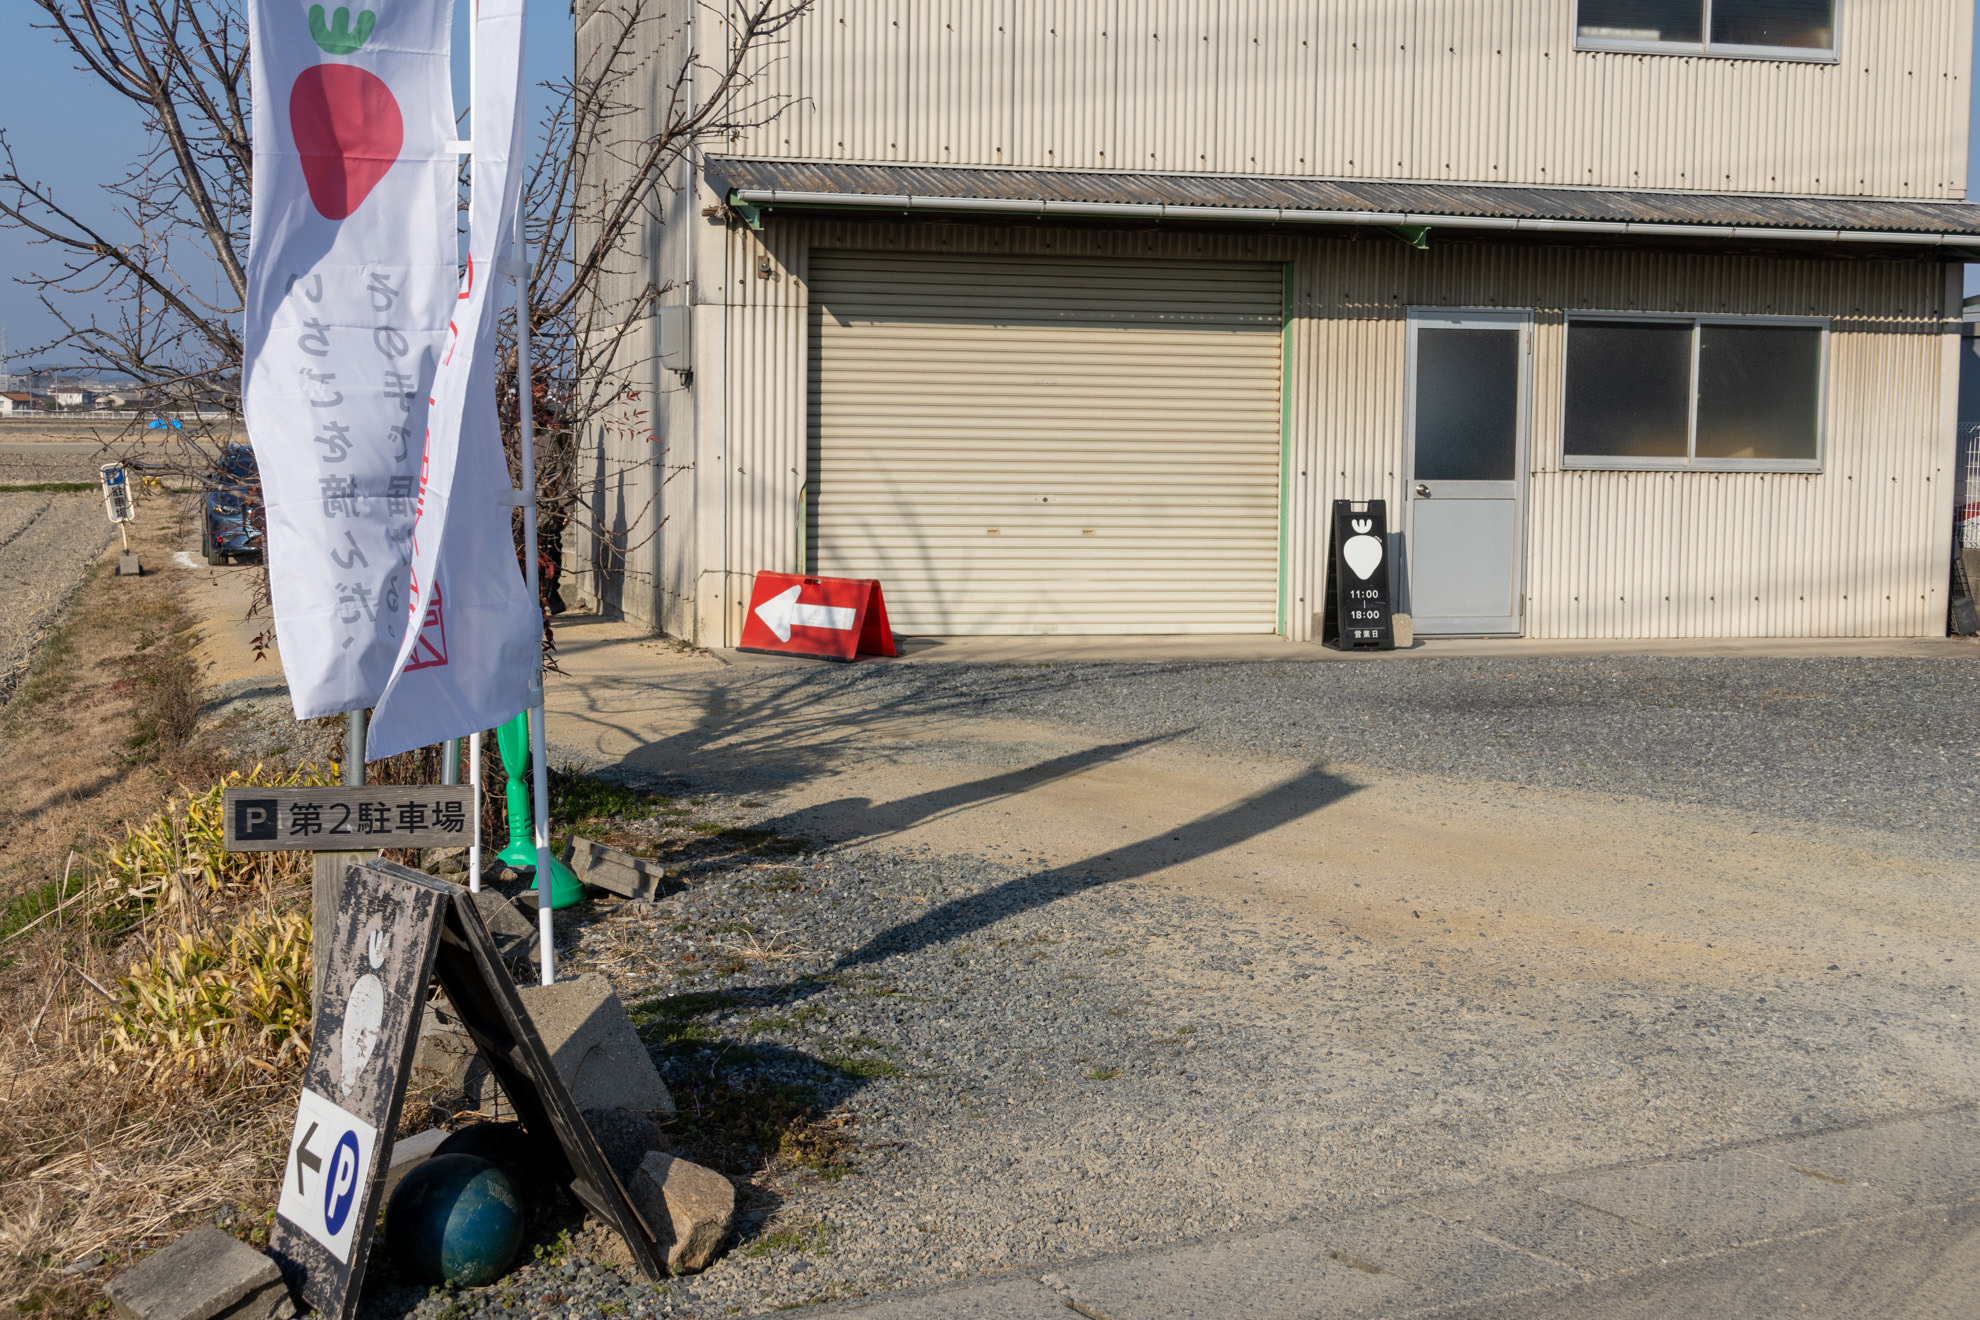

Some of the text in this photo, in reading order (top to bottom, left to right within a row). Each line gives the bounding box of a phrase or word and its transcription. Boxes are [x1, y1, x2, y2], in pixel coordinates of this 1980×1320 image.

[1350, 590, 1379, 599] 11:00
[1350, 610, 1380, 619] 18:00
[1354, 630, 1379, 638] 営業日
[247, 800, 466, 837] P 第2駐車場
[328, 1143, 356, 1220] P
